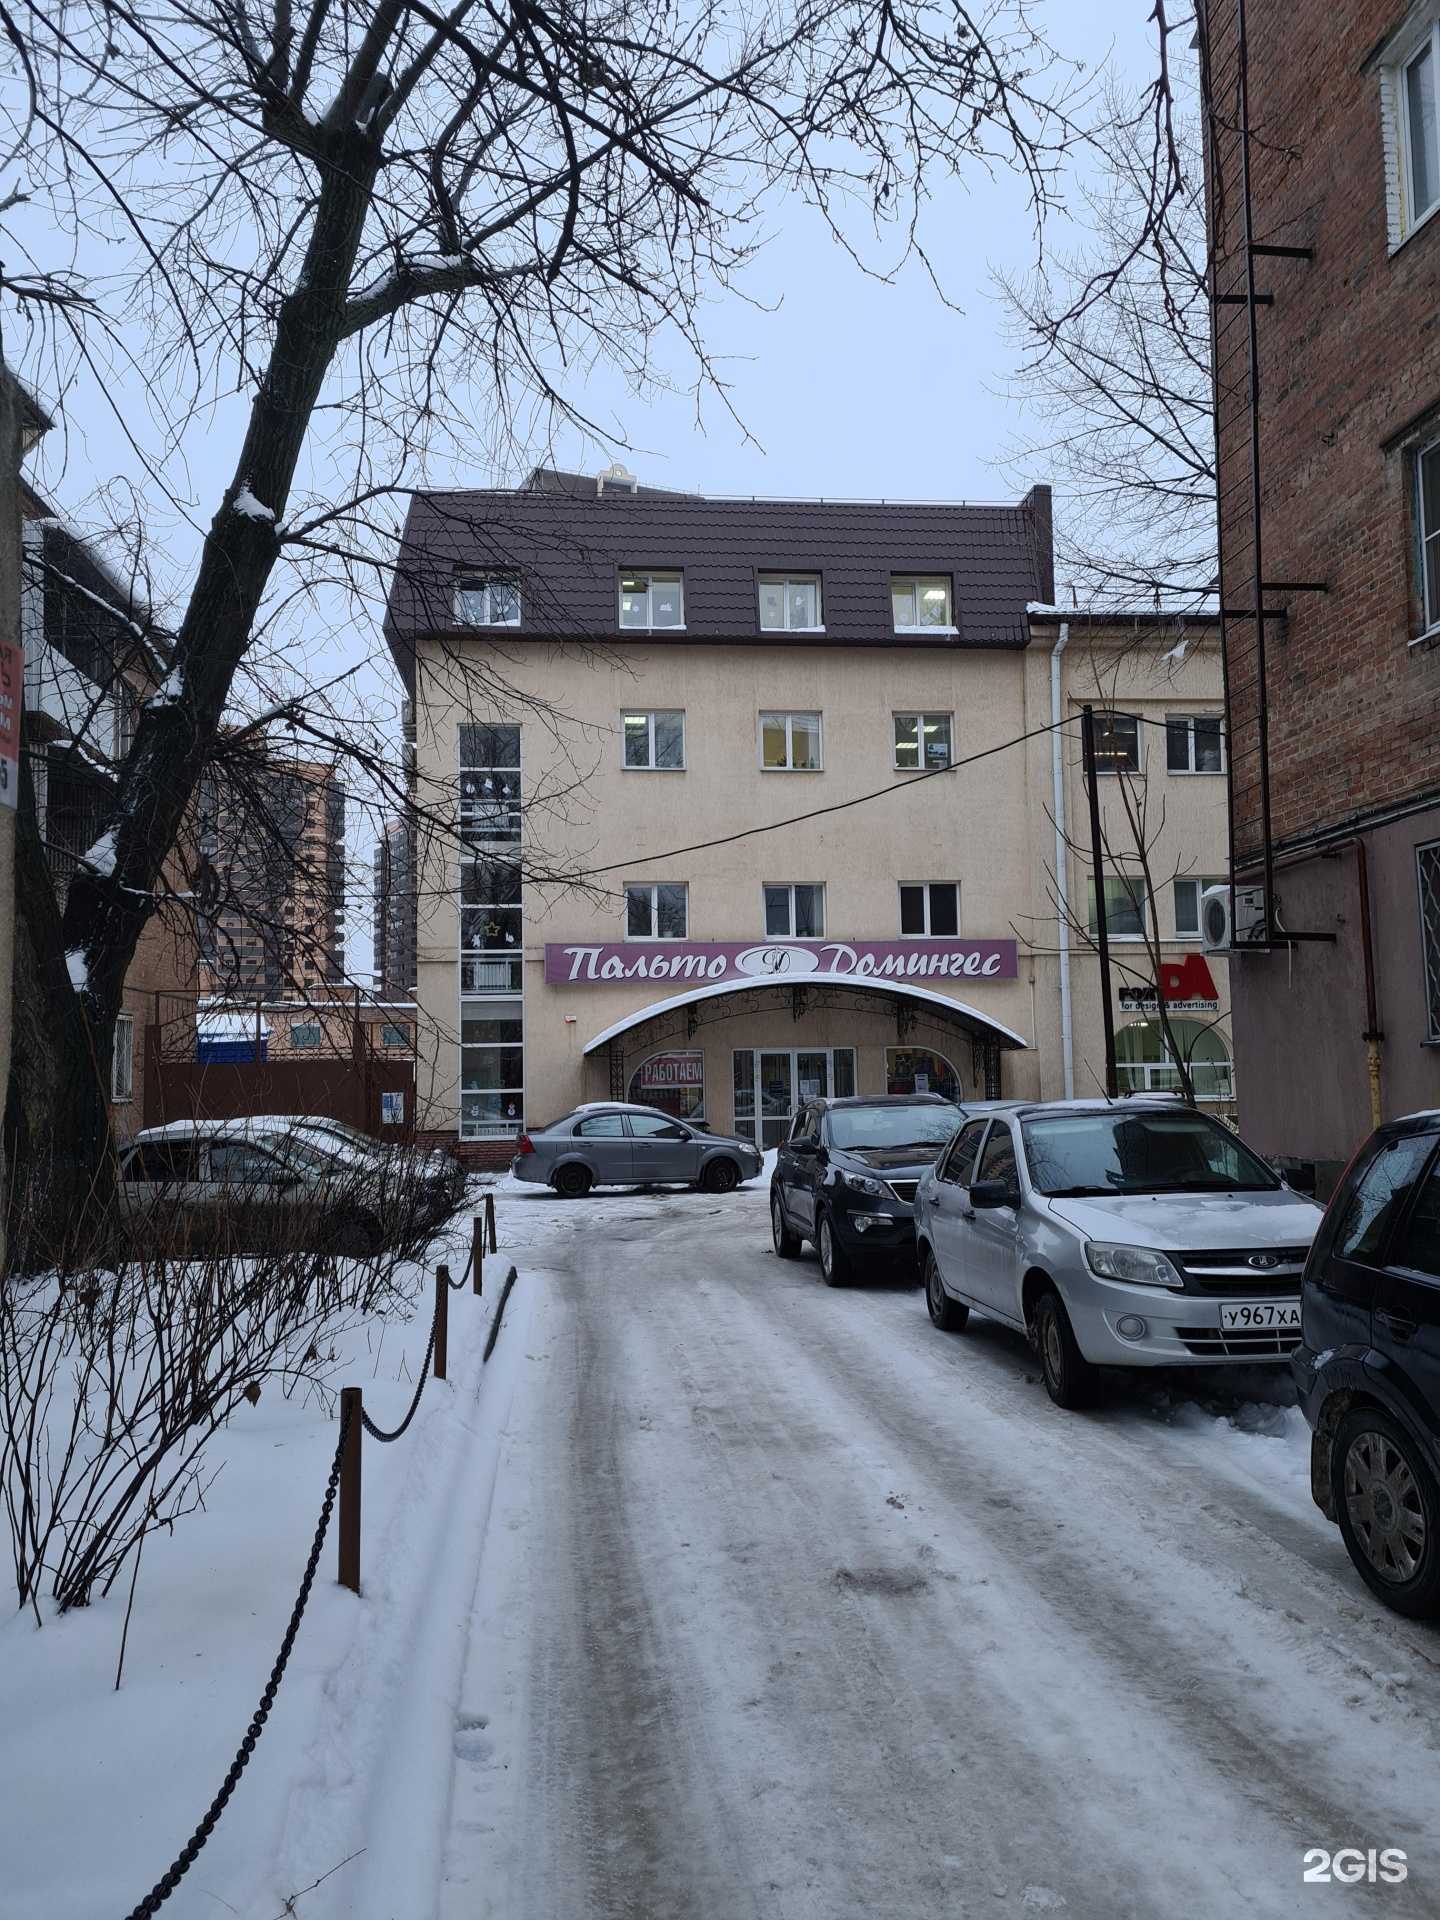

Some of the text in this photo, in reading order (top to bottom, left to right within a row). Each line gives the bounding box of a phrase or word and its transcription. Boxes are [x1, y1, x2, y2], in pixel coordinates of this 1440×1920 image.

[563, 945, 727, 981] Пальто
[819, 943, 1002, 977] Домингес
[1173, 1001, 1218, 1011] advertising
[645, 1062, 703, 1081] РАБОТАЕМ
